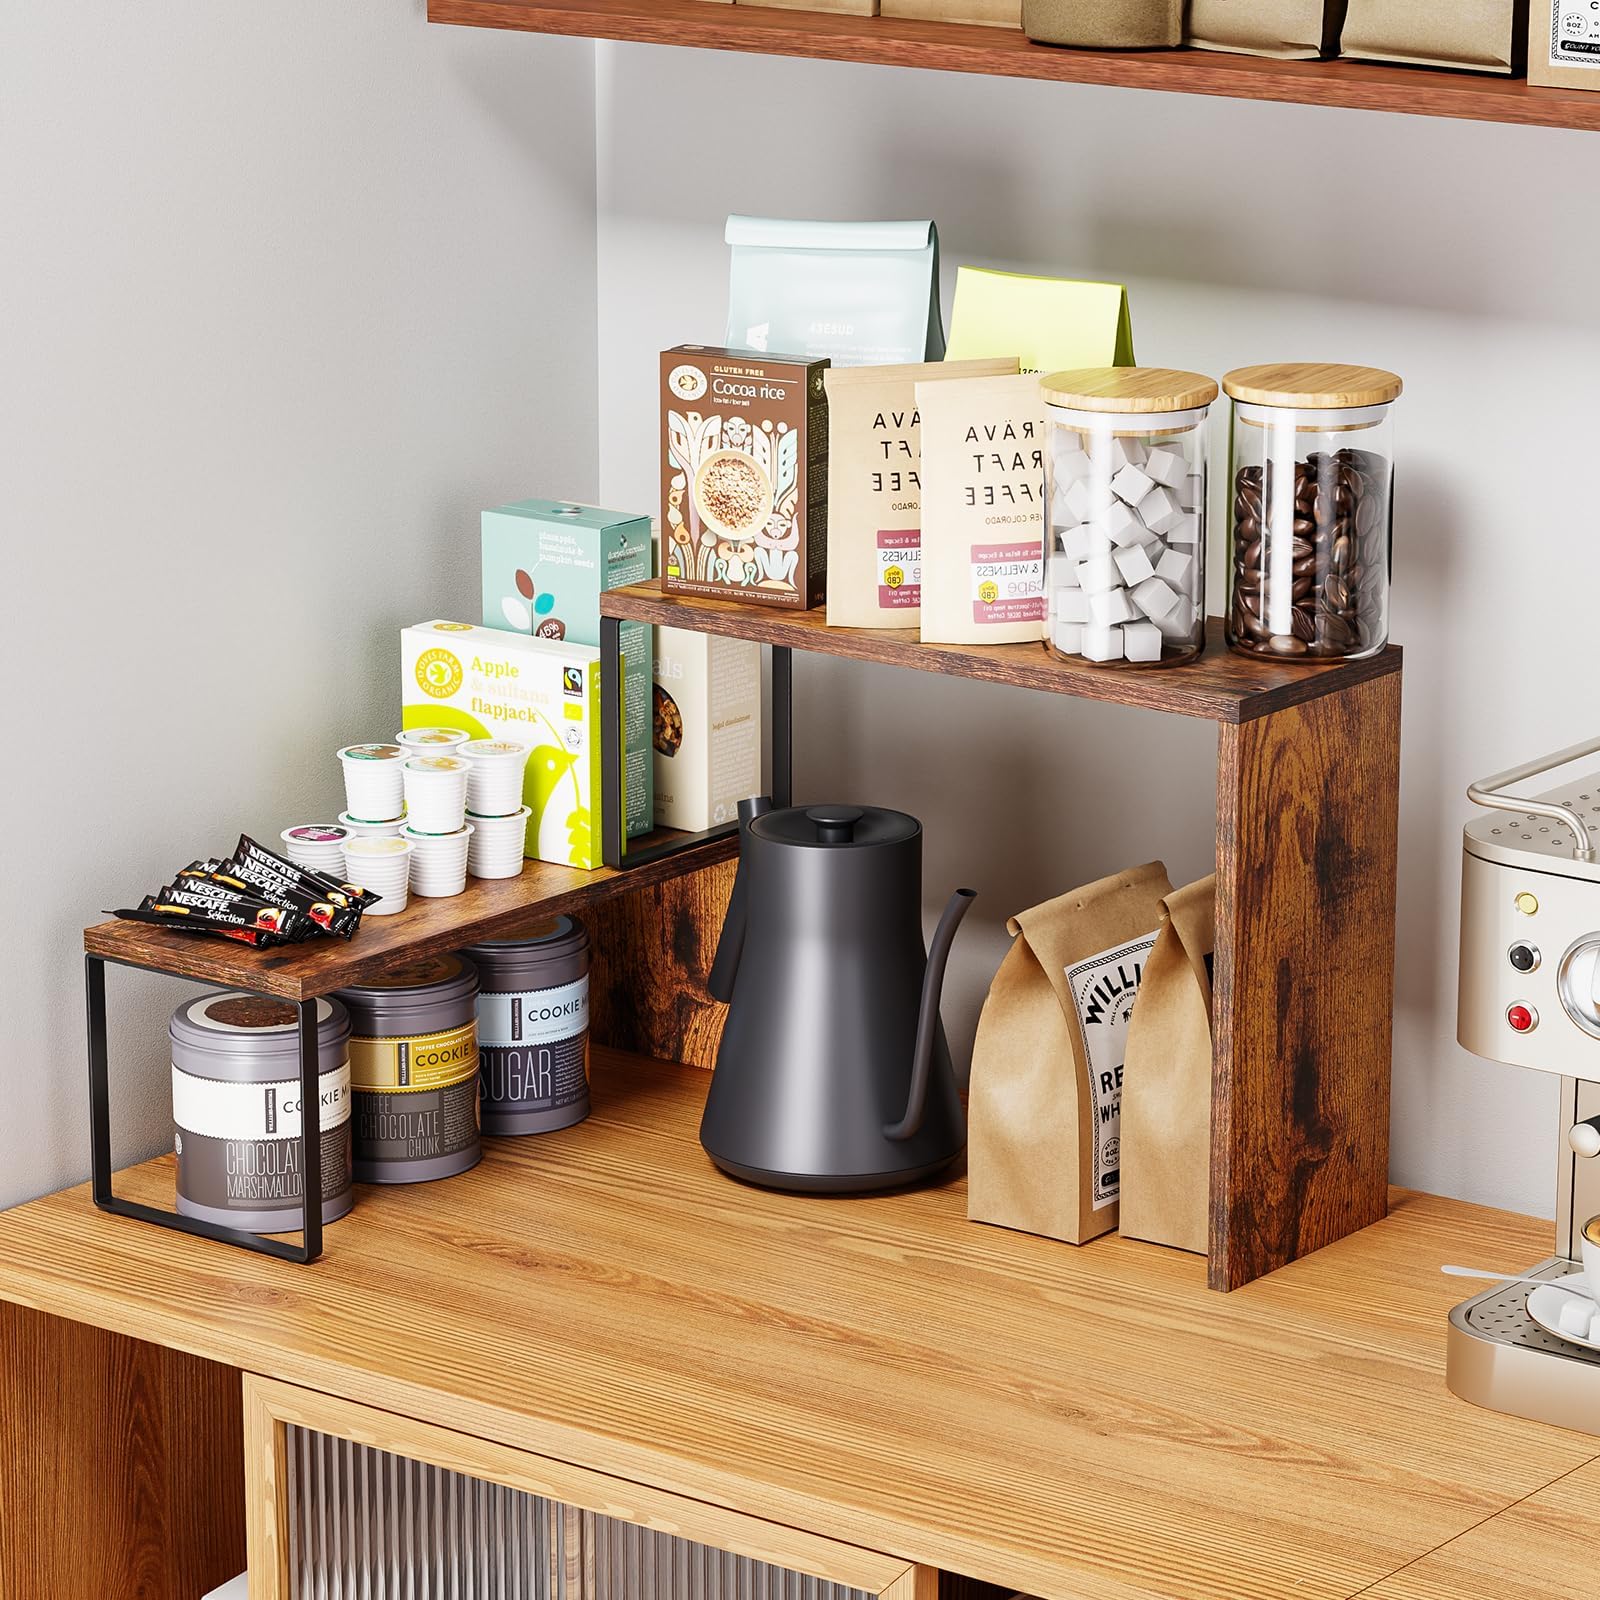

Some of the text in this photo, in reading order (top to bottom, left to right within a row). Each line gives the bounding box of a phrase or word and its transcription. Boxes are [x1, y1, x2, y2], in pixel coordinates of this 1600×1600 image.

[714, 365, 764, 376] GLUTEN FREE
[713, 378, 757, 398] Cocoa
[760, 384, 785, 401] rice
[471, 656, 519, 678] Apple
[421, 675, 459, 697] ORGANIC
[471, 697, 537, 723] flapjack
[260, 890, 299, 911] Sélection
[206, 909, 245, 925] Sélection
[528, 999, 580, 1022] COOKIE
[415, 1043, 435, 1052] TOFFEE
[436, 1038, 462, 1048] CHOCOLATE
[415, 1043, 469, 1067] COOKIE
[360, 1111, 440, 1140] CHOCOLATE
[408, 1136, 441, 1158] CHUNK
[227, 1173, 303, 1198] MARSHMALLO
